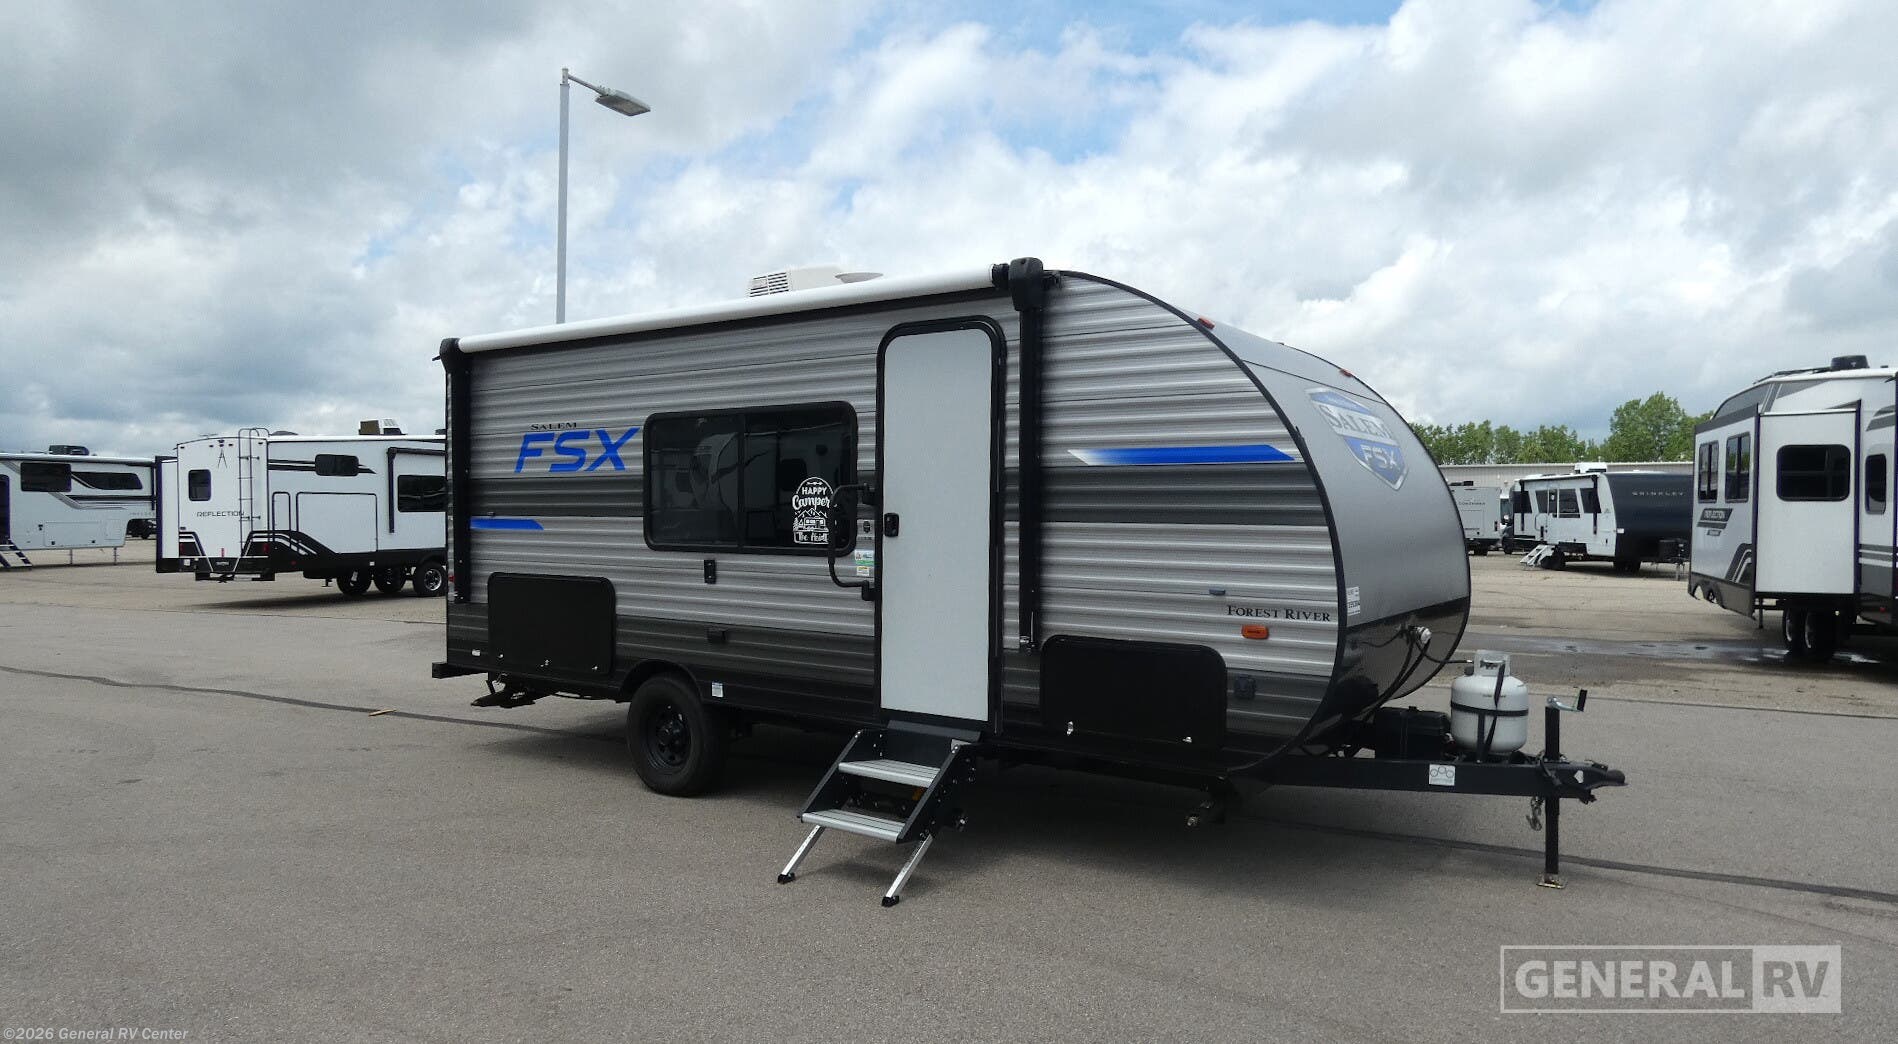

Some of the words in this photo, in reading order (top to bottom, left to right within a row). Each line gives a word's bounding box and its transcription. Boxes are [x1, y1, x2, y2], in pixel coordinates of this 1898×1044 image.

[530, 422, 577, 431] SALEM
[1319, 405, 1392, 439] SALEM
[514, 427, 640, 473] FSX
[1360, 444, 1397, 469] FSX
[801, 486, 827, 495] HAPPY
[792, 494, 830, 510] Camper
[1227, 604, 1278, 618] FOREST
[1285, 608, 1330, 622] RIVER
